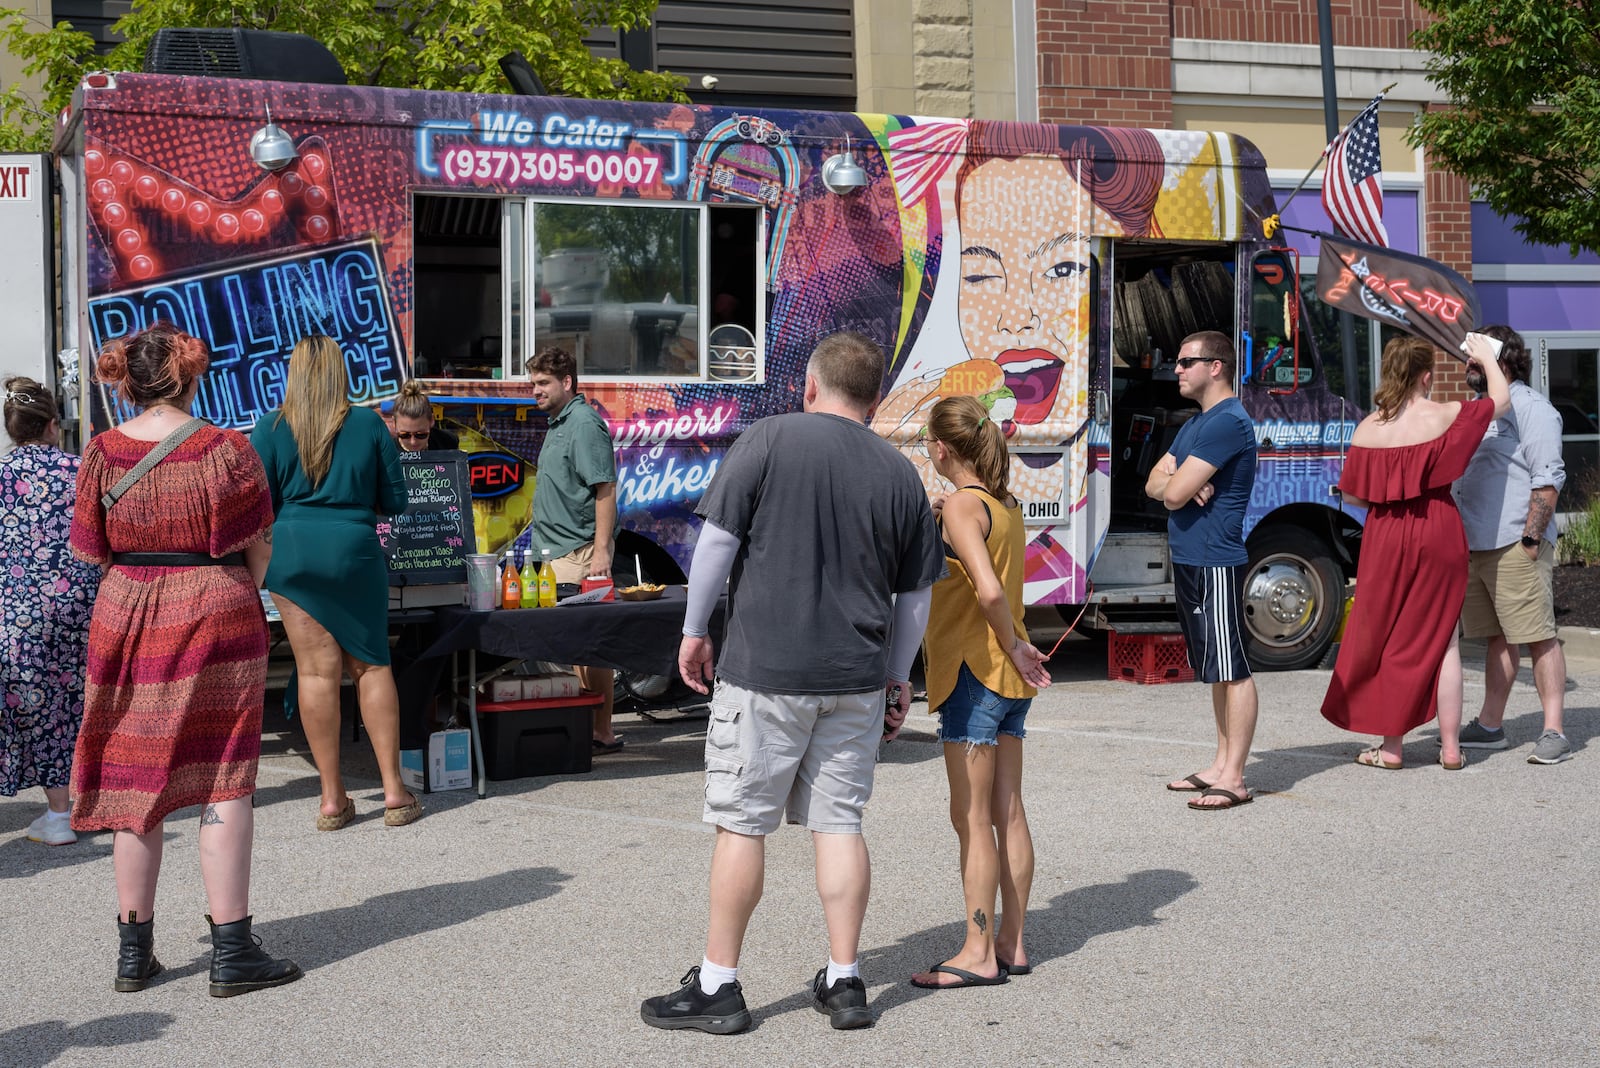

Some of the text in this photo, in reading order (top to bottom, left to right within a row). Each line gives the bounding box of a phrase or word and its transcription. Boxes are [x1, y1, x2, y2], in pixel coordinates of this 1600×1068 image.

[483, 112, 533, 143] We
[545, 115, 628, 147] Cater
[445, 149, 659, 184] (937)305-0007
[0, 167, 29, 198] XIT
[942, 370, 987, 392] ERTS
[612, 406, 733, 459] urgers
[409, 466, 436, 479] Queso
[471, 463, 519, 486] PEN
[635, 454, 655, 476] &
[616, 457, 718, 506] hakes
[1250, 480, 1328, 508] GARLIC
[1029, 502, 1060, 517] OHIO
[432, 546, 453, 556] Toast
[389, 559, 413, 570] Crunch
